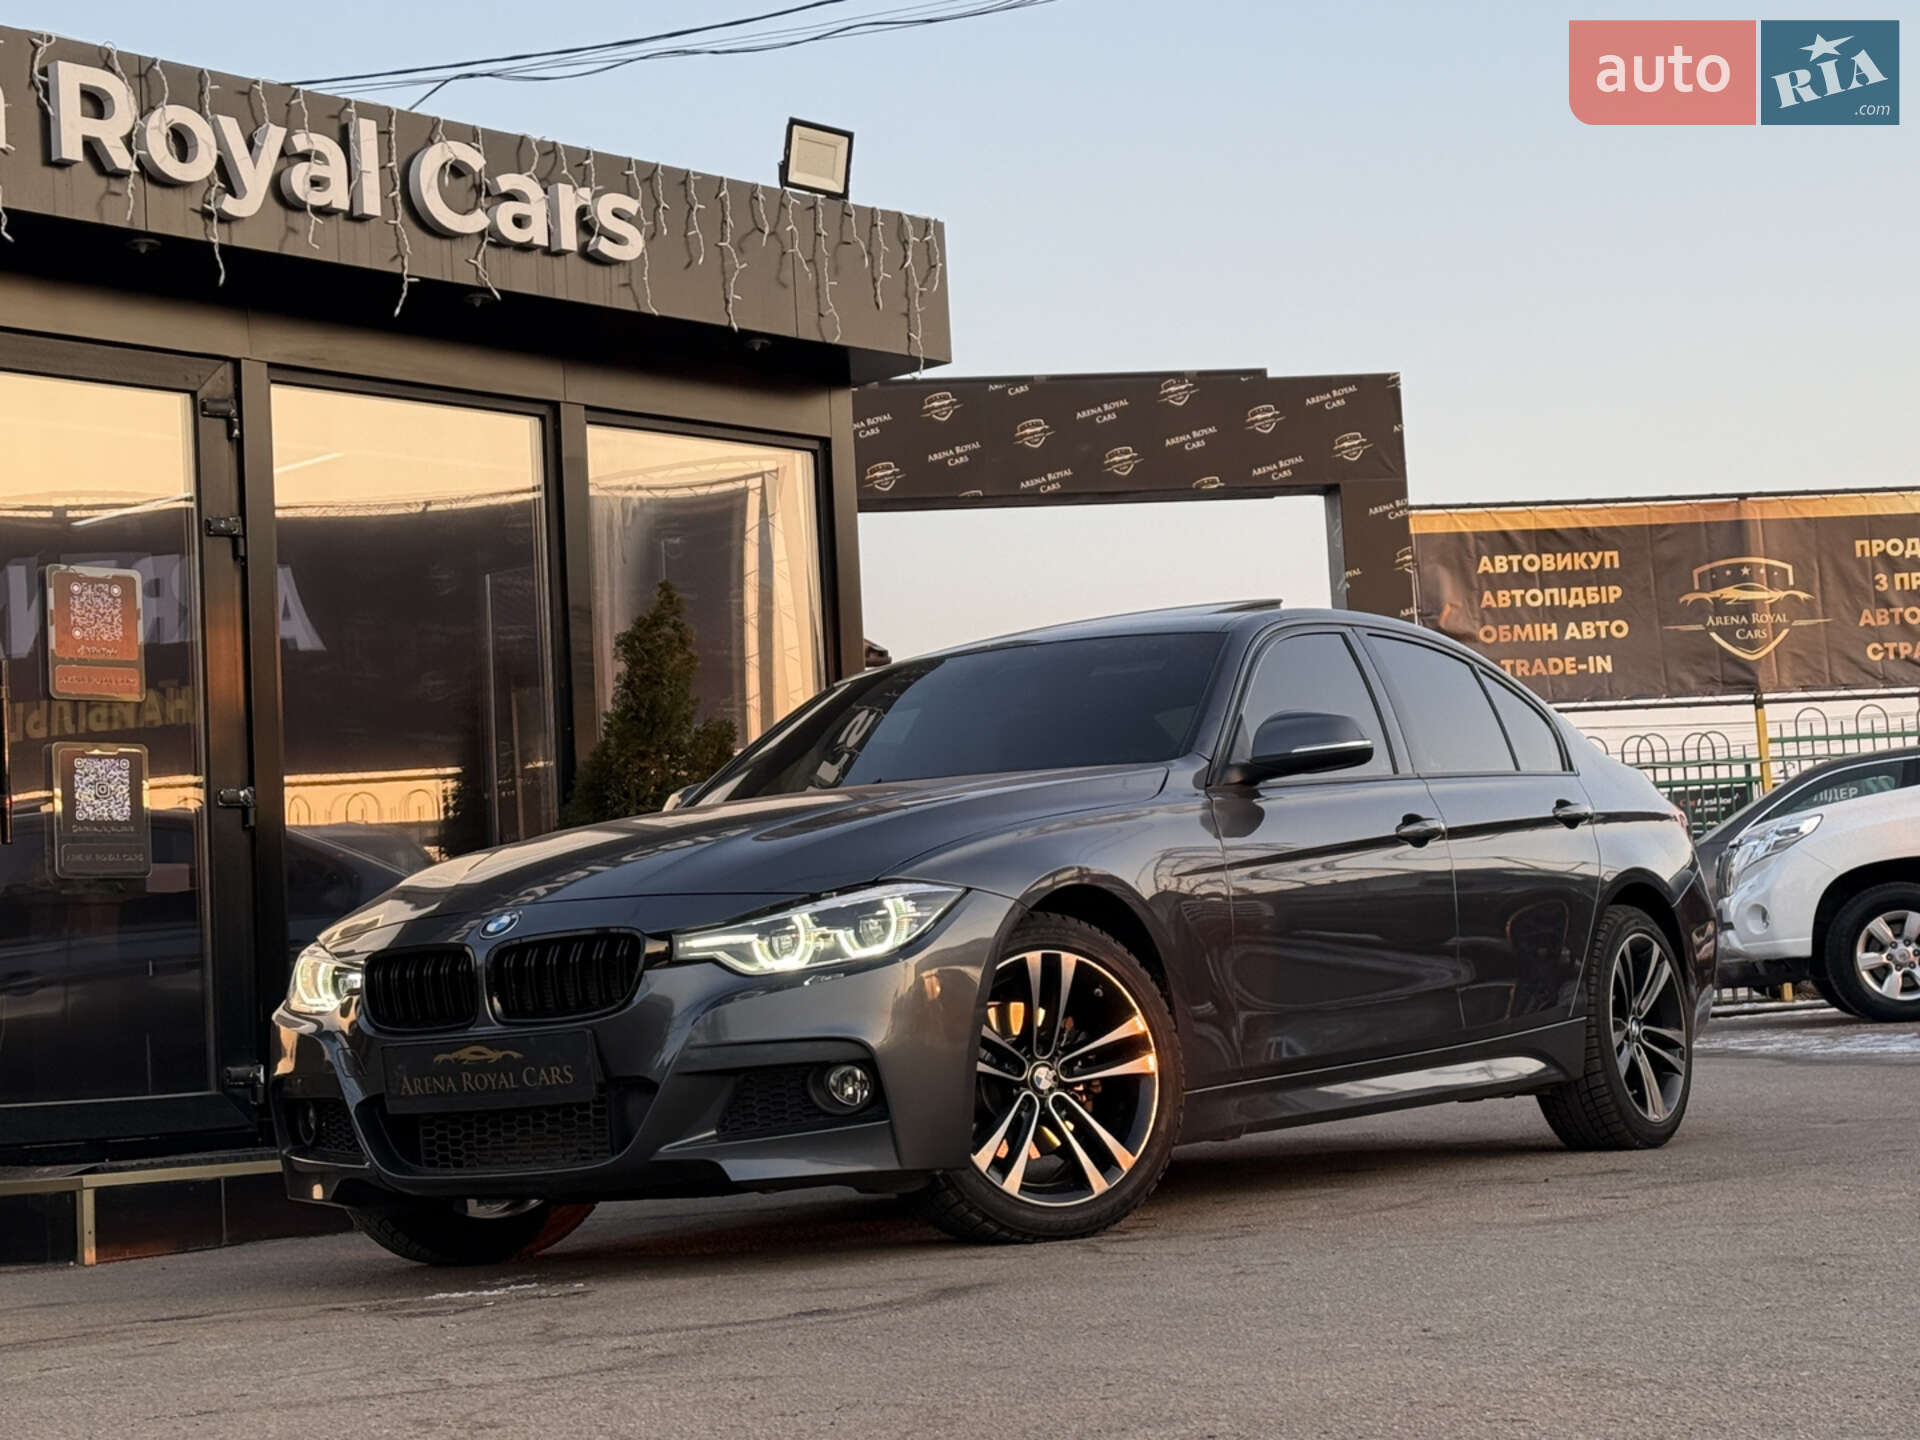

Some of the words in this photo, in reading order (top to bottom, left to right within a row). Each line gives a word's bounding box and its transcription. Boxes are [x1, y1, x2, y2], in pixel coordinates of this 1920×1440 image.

[49, 60, 380, 220] Royal
[410, 140, 643, 264] Cars
[1855, 537, 1920, 558] ПРОД
[1477, 550, 1620, 574] АВТОВИКУП
[1480, 585, 1623, 608] АВТОПІДБІР
[1706, 615, 1749, 627] ARENA
[1751, 612, 1789, 624] ROYAL
[1859, 606, 1920, 627] АВТО
[1479, 622, 1558, 644] ОБМІН
[1564, 619, 1629, 640] АВТО
[1735, 628, 1768, 640] CARS
[1500, 655, 1613, 677] TRADE-IN
[401, 1074, 457, 1097] ARENA
[462, 1071, 518, 1092] ROYAL
[522, 1064, 574, 1085] CARS
